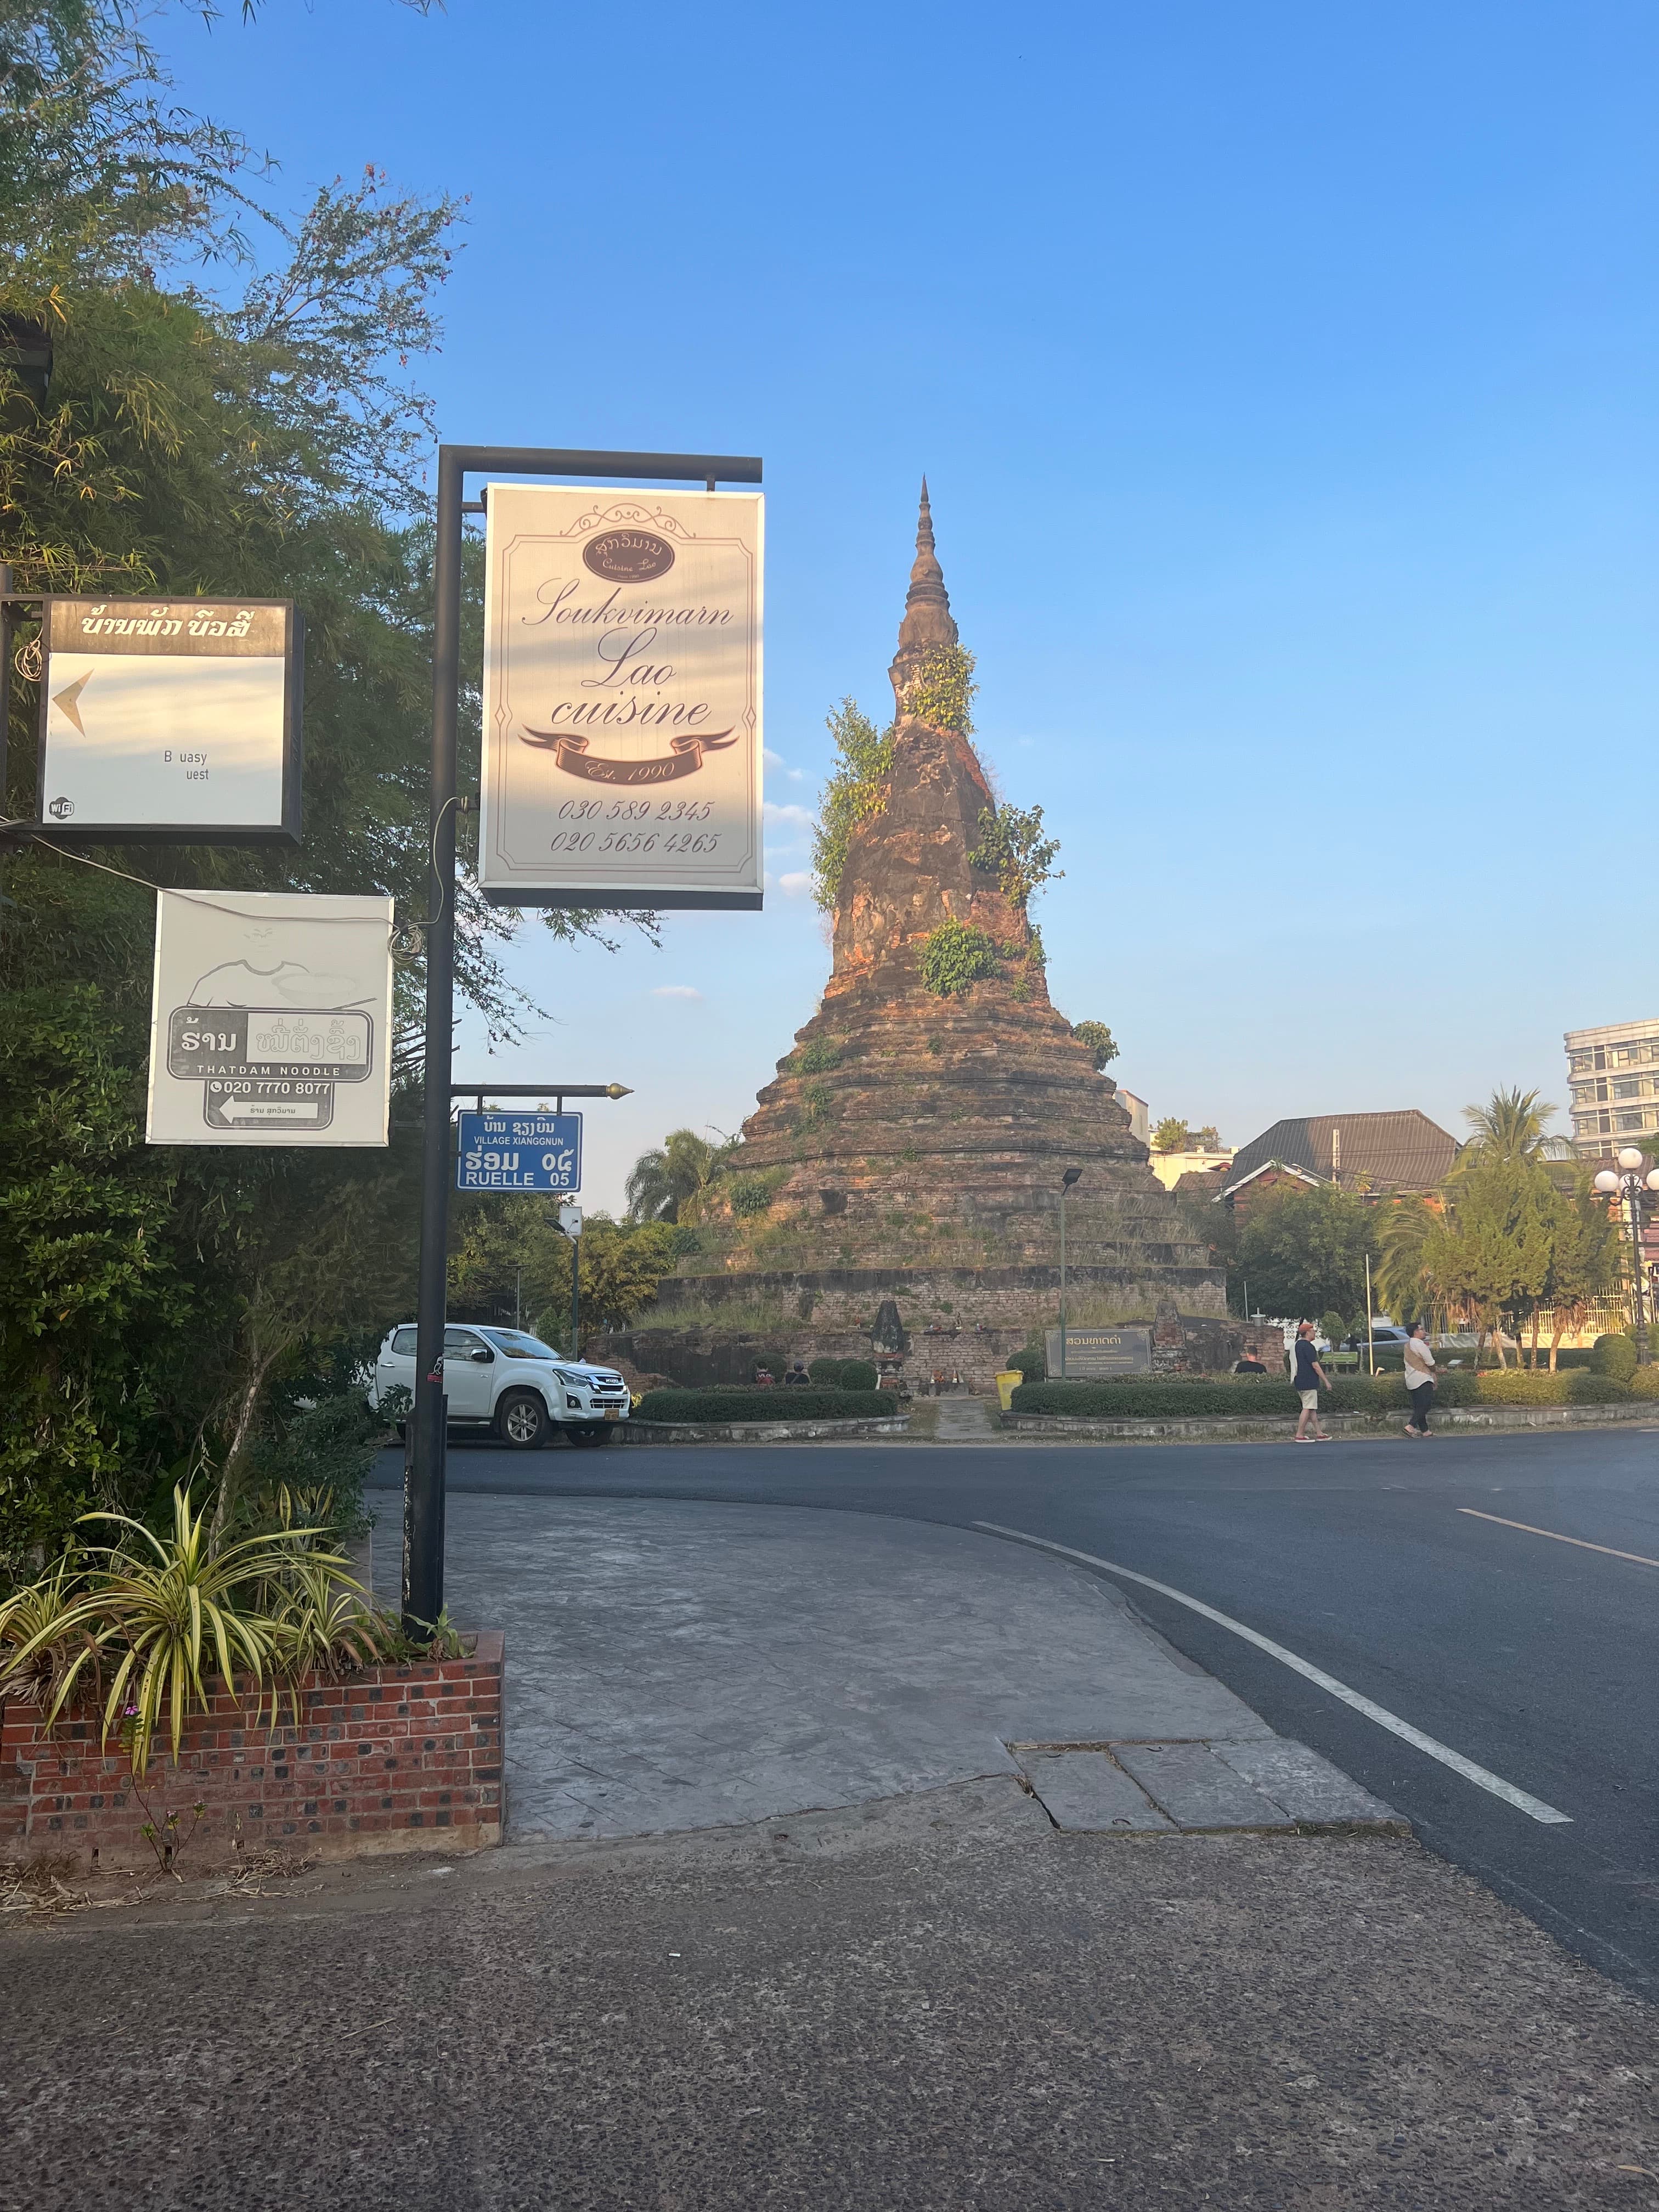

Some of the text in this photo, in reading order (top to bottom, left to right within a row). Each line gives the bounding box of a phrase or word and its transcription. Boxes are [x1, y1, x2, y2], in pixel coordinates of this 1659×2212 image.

[602, 557, 633, 572] Cuisine
[521, 577, 733, 626] Soukvimarn
[580, 627, 676, 688] Lao
[551, 690, 712, 725] cuisine
[585, 760, 675, 781] Est. 1990
[558, 800, 715, 821] 030 589 2345
[551, 832, 723, 853] 020 5656 4265
[197, 1065, 340, 1076] THATDAM NOODLE
[223, 1081, 330, 1094] 020 7770 8077
[474, 1136, 563, 1146] VILLAGE XIANGGNUN
[466, 1172, 570, 1186] RUELLE 05
